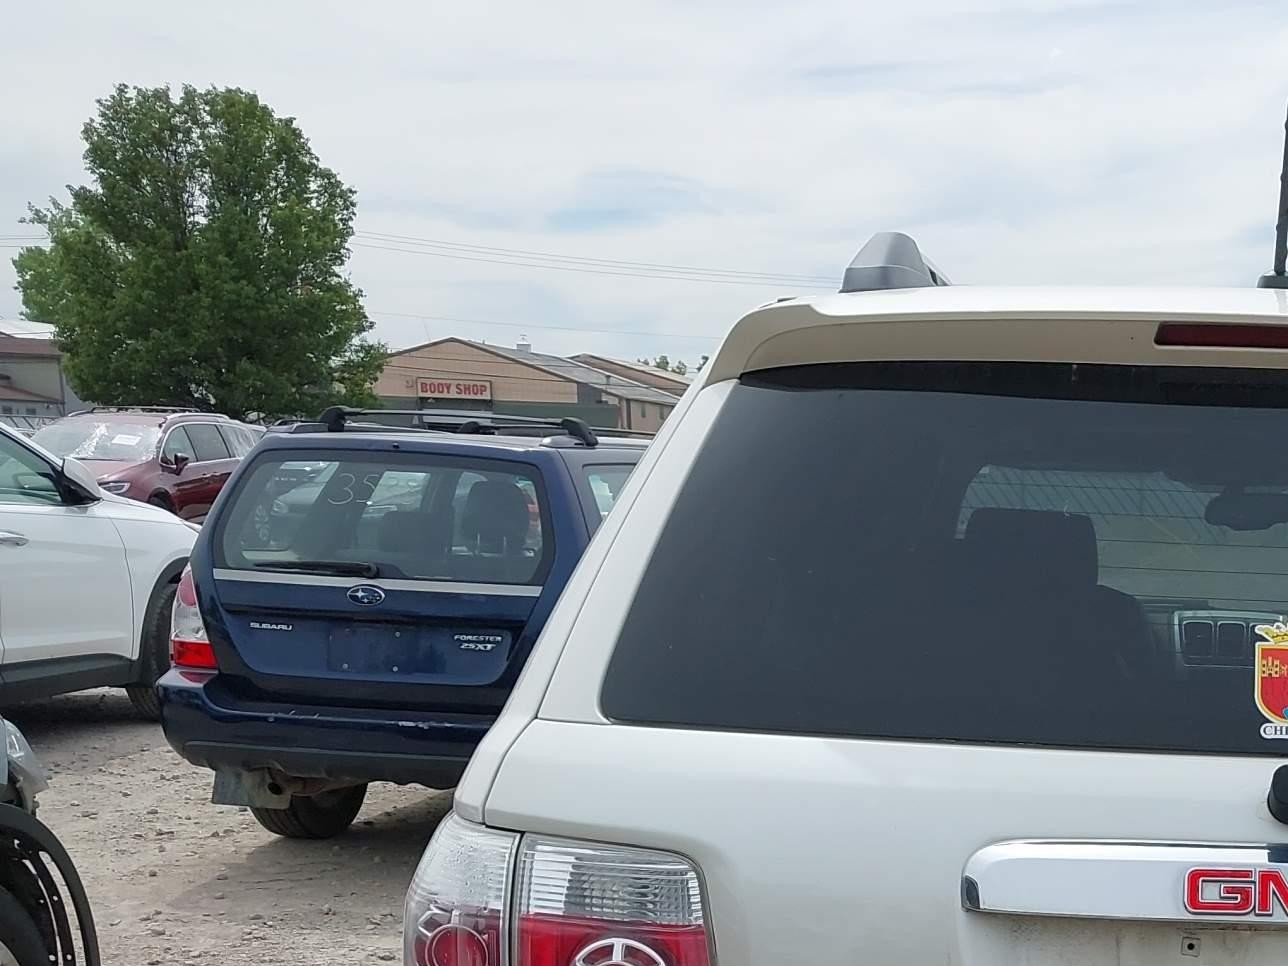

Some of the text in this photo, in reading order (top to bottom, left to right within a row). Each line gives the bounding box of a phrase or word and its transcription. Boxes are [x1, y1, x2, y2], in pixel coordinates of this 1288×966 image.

[420, 382, 487, 395] BODY SHOP
[250, 622, 292, 631] SUBARU
